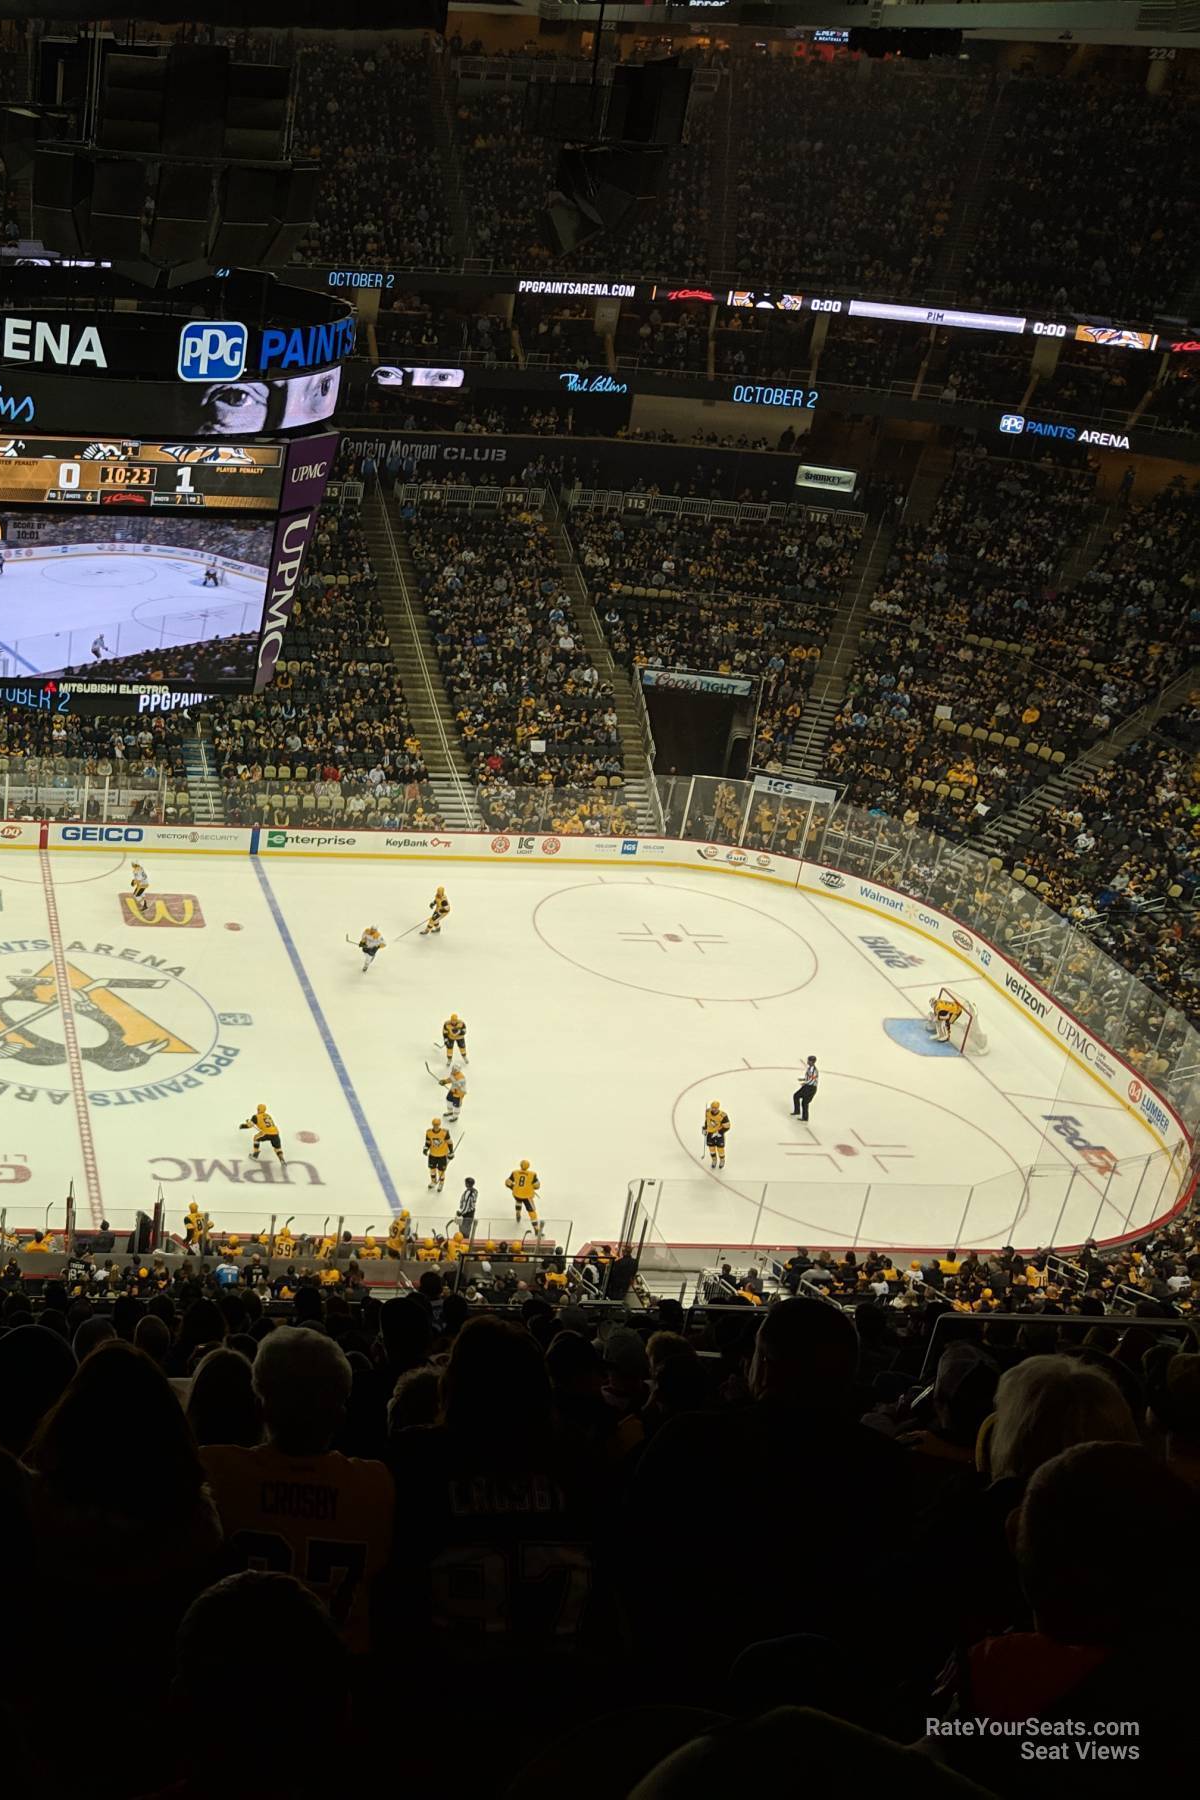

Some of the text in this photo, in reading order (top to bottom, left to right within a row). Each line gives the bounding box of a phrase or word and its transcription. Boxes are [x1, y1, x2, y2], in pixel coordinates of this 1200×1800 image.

[1148, 48, 1176, 60] 224
[328, 273, 395, 292] OCTOBER 2
[518, 281, 636, 298] PPGPAINTSARENA.COM
[810, 299, 842, 312] 0:00
[927, 312, 944, 322] PIM
[1033, 322, 1067, 337] 0:00
[184, 316, 358, 375] PPG PAINTS
[560, 373, 628, 393] Phil Collins
[733, 386, 818, 409] OCTOBER 2
[1000, 415, 1130, 449] PPG PAINTS ARENA
[126, 447, 134, 456] 1
[340, 437, 507, 466] Captain Morgan CLUB
[58, 463, 80, 488] 0
[105, 467, 151, 484] 10:23
[175, 466, 195, 492] 1
[239, 467, 264, 475] PENALTY
[291, 461, 328, 483] UPMC
[86, 492, 93, 501] 6
[175, 495, 183, 504] 7
[423, 491, 441, 501] 114
[506, 493, 524, 503] 114
[628, 498, 646, 509] 115
[17, 530, 40, 540] 10:01
[257, 513, 312, 669] UPMC
[59, 683, 170, 695] MITSUBISHI ELECTRIC
[656, 671, 737, 696] Coors LIGHT
[57, 692, 72, 713] 2
[766, 779, 793, 795] IGS
[62, 827, 143, 842] GEICO
[272, 834, 356, 847] enterprise
[386, 838, 428, 848] KeyBank
[517, 837, 535, 850] IC
[623, 843, 636, 852] IGS
[726, 854, 746, 863] Gulf
[860, 887, 940, 930] Walmart com
[66, 941, 186, 977] ARENA
[1005, 972, 1044, 1019] verizon
[1056, 1016, 1098, 1062] UPMC
[193, 1044, 241, 1077] PPG
[88, 1074, 204, 1107] PAINTS
[1129, 1082, 1142, 1099] 84
[1141, 1094, 1170, 1132] LUMBER
[147, 1156, 327, 1186] UPMC
[518, 1175, 526, 1187] 8
[276, 1243, 292, 1256] 59
[259, 1481, 338, 1519] CROSBY
[447, 1474, 567, 1515] CROSBY
